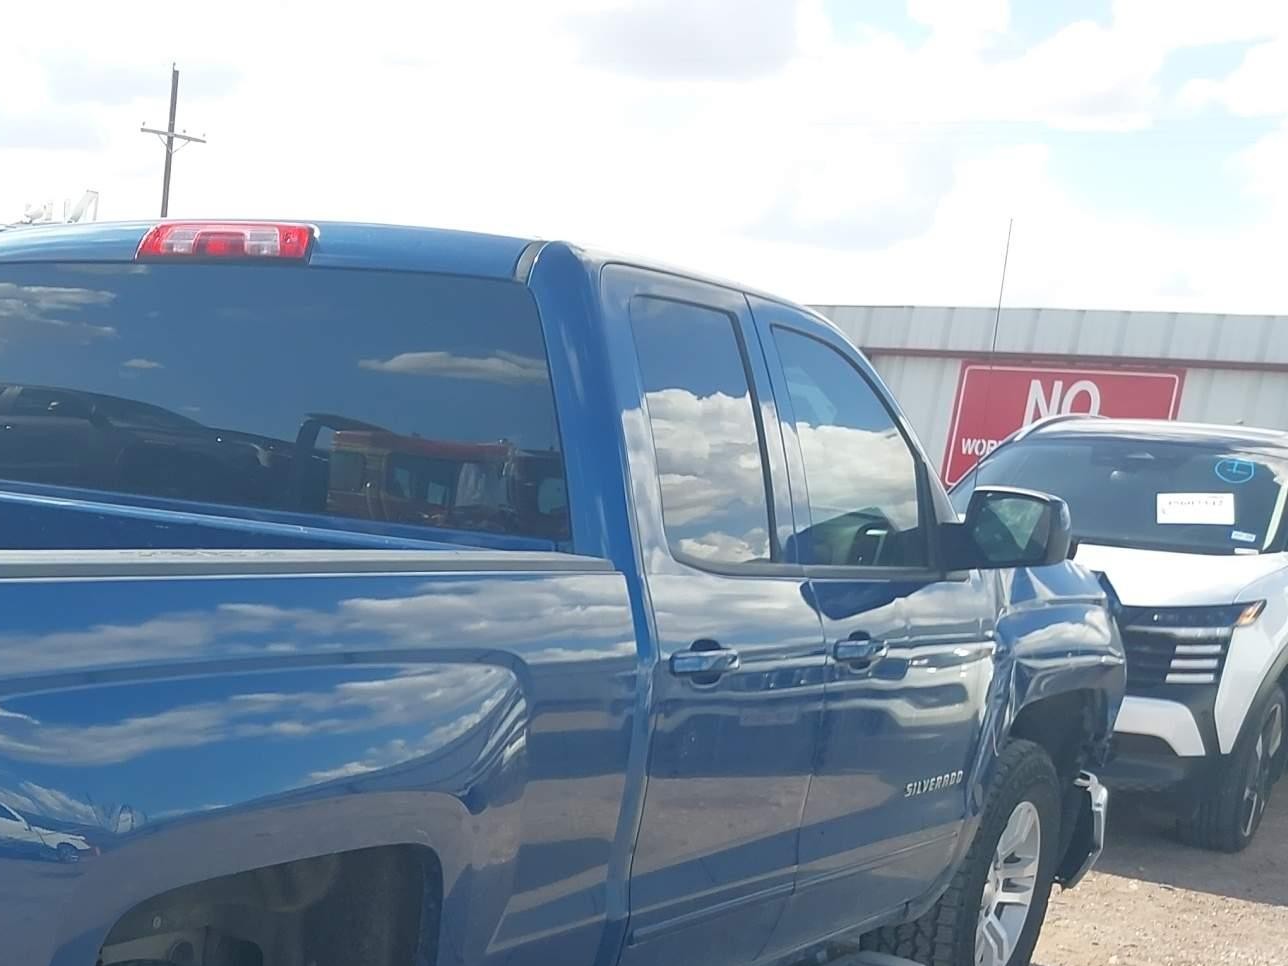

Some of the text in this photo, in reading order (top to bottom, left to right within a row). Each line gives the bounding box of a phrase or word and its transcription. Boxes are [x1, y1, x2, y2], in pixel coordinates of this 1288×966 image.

[1022, 379, 1101, 428] NO
[961, 437, 1003, 456] WOR
[904, 769, 964, 798] SILVERADO
